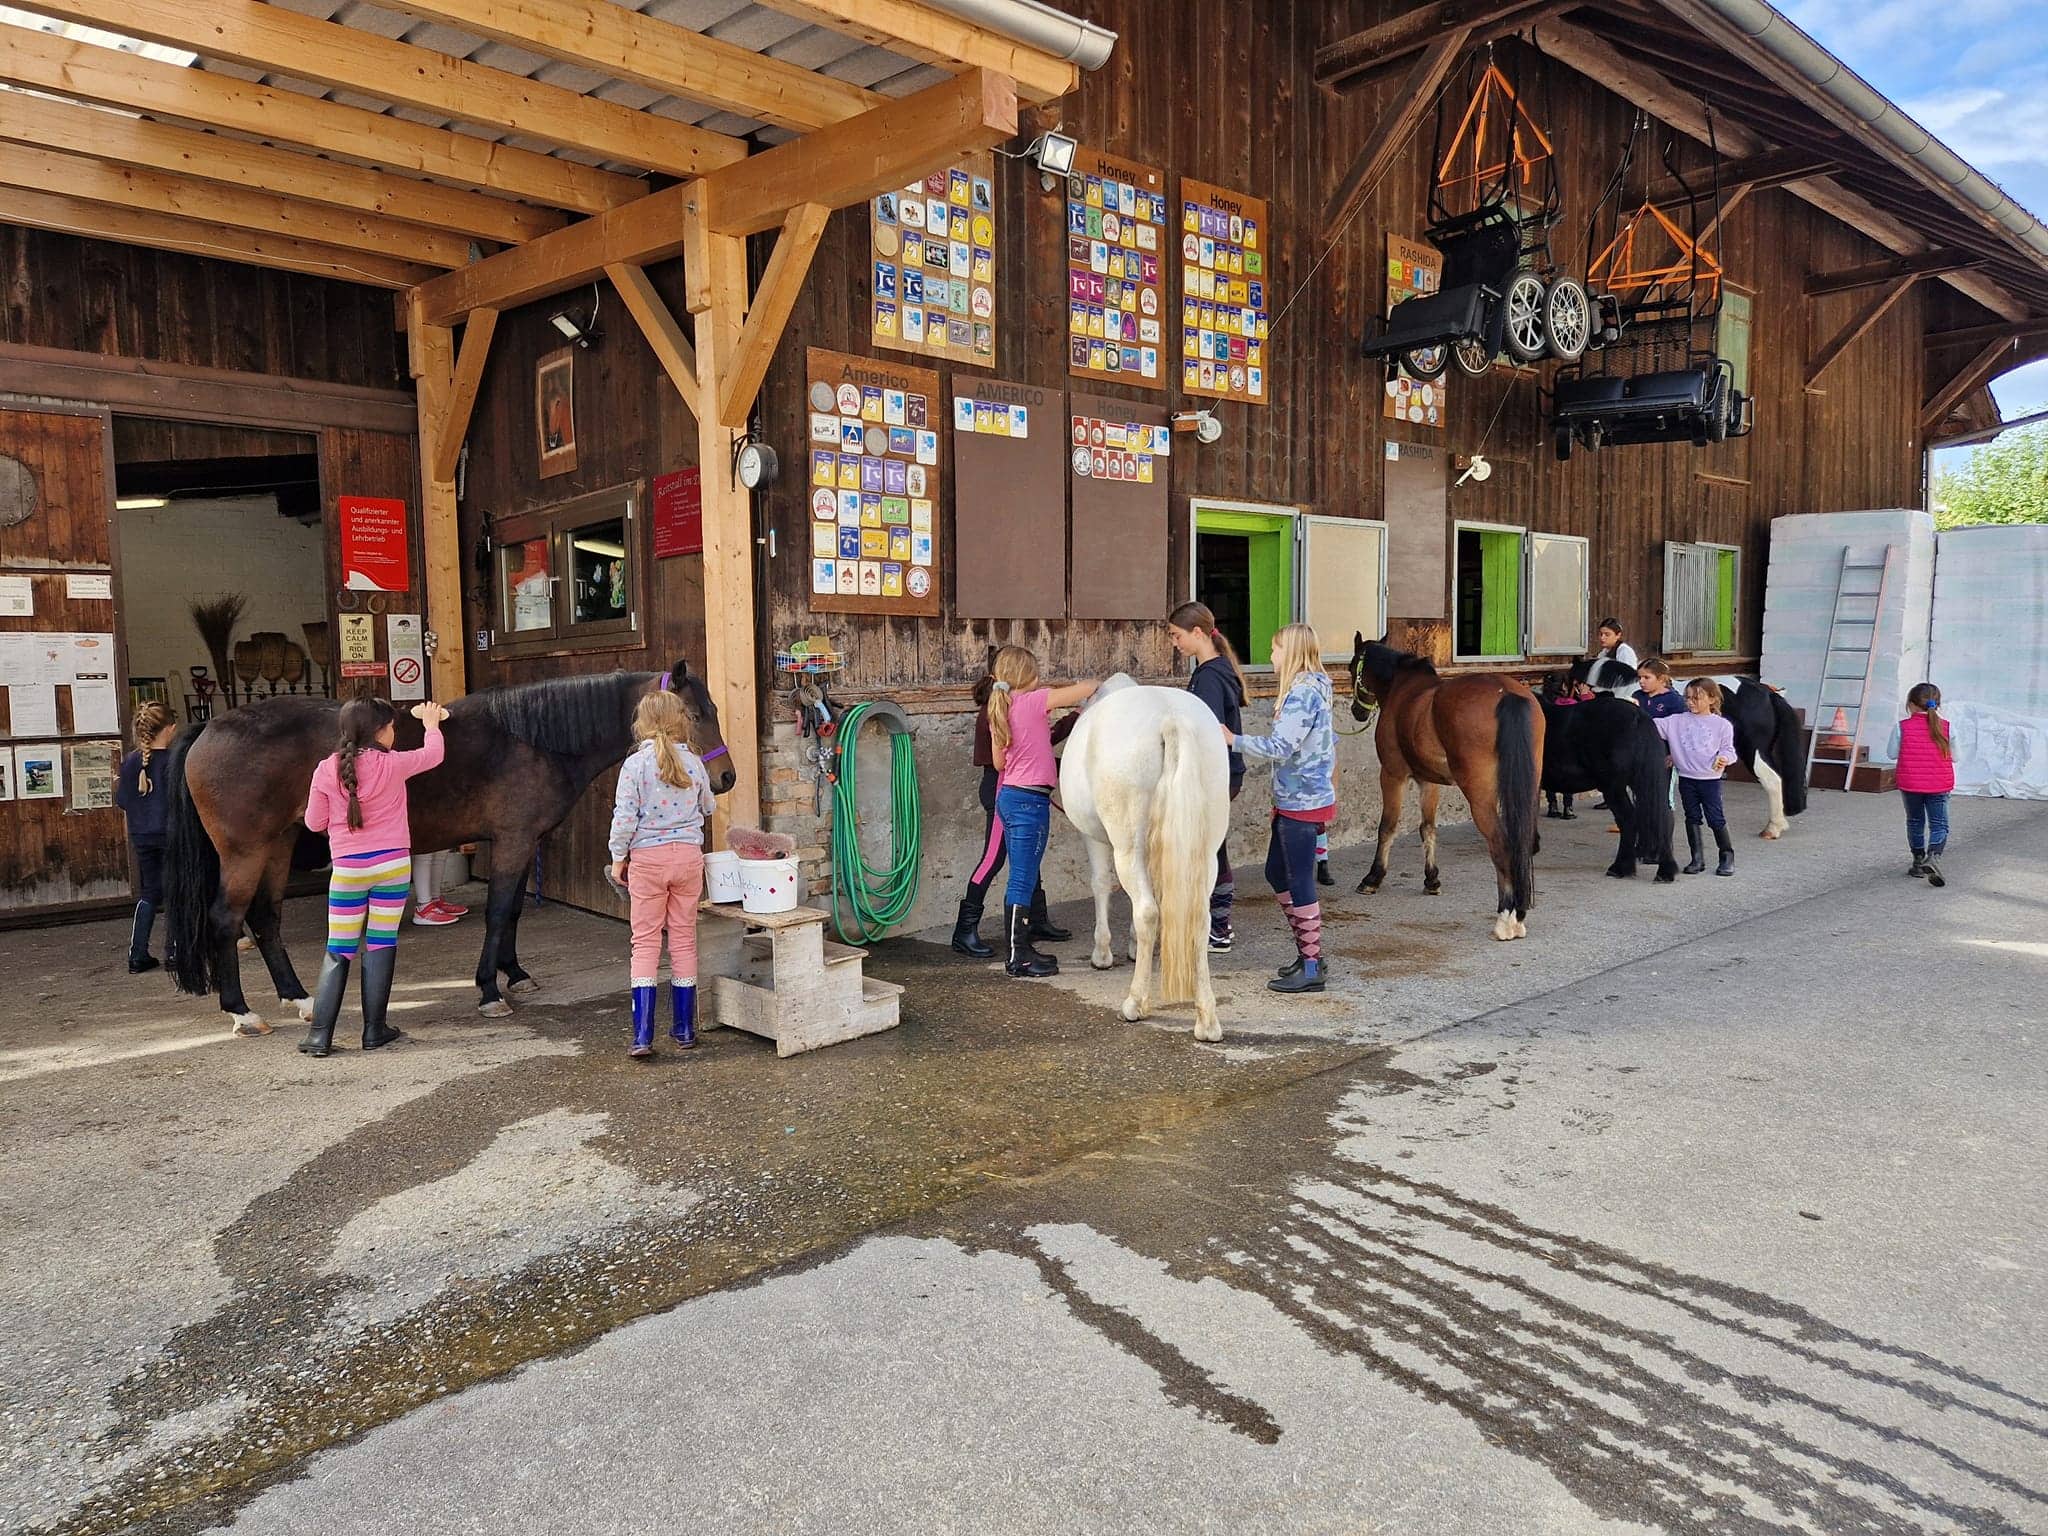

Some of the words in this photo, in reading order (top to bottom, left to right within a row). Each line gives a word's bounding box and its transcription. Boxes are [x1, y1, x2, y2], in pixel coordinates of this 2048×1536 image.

[1098, 159, 1136, 186] Honey
[1210, 192, 1242, 216] Honey
[1400, 245, 1437, 270] RASHIDA
[841, 363, 909, 389] Americo
[975, 382, 1044, 406] AMERICO
[1097, 399, 1137, 420] Honey
[1399, 444, 1433, 460] RASHIDA
[351, 506, 389, 516] Qualifizierter
[364, 517, 401, 526] anerkannter
[352, 534, 386, 543] Lehrbetrieb
[391, 527, 403, 535] und
[346, 628, 368, 636] KEEP
